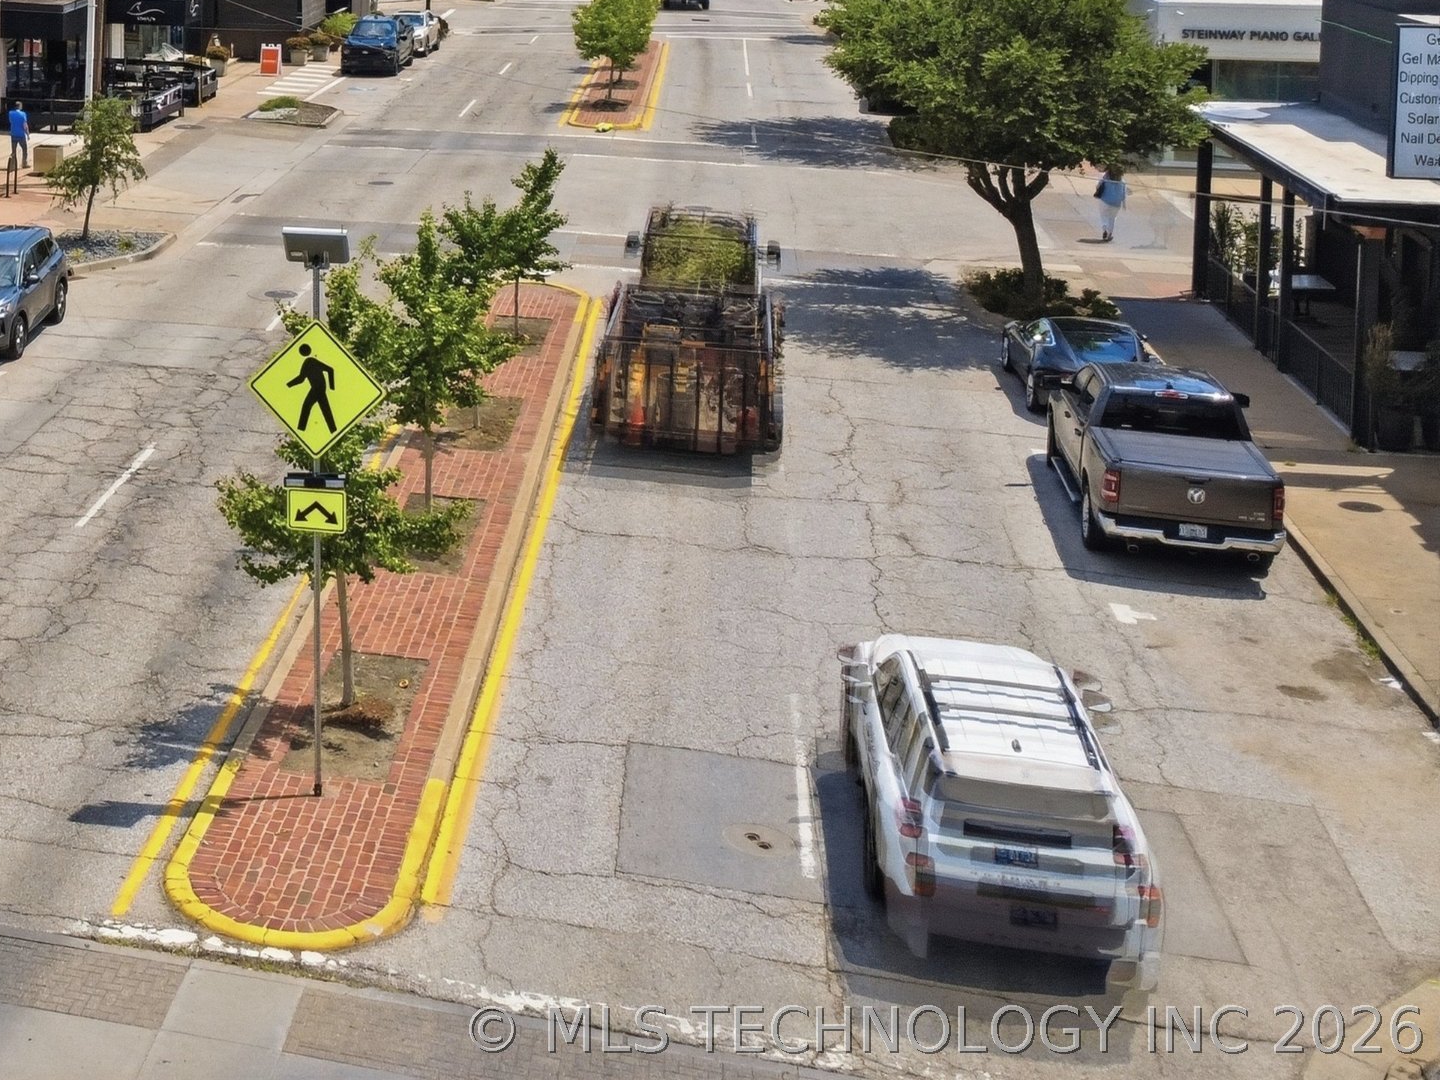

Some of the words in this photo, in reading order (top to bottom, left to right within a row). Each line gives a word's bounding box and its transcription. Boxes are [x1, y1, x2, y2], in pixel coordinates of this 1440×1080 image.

[1181, 28, 1246, 41] STEINWAY
[1249, 30, 1289, 42] PIANO
[1402, 52, 1423, 65] Gel
[1399, 70, 1439, 87] Dipping
[1407, 112, 1440, 125] Solar
[1400, 132, 1424, 145] Nail
